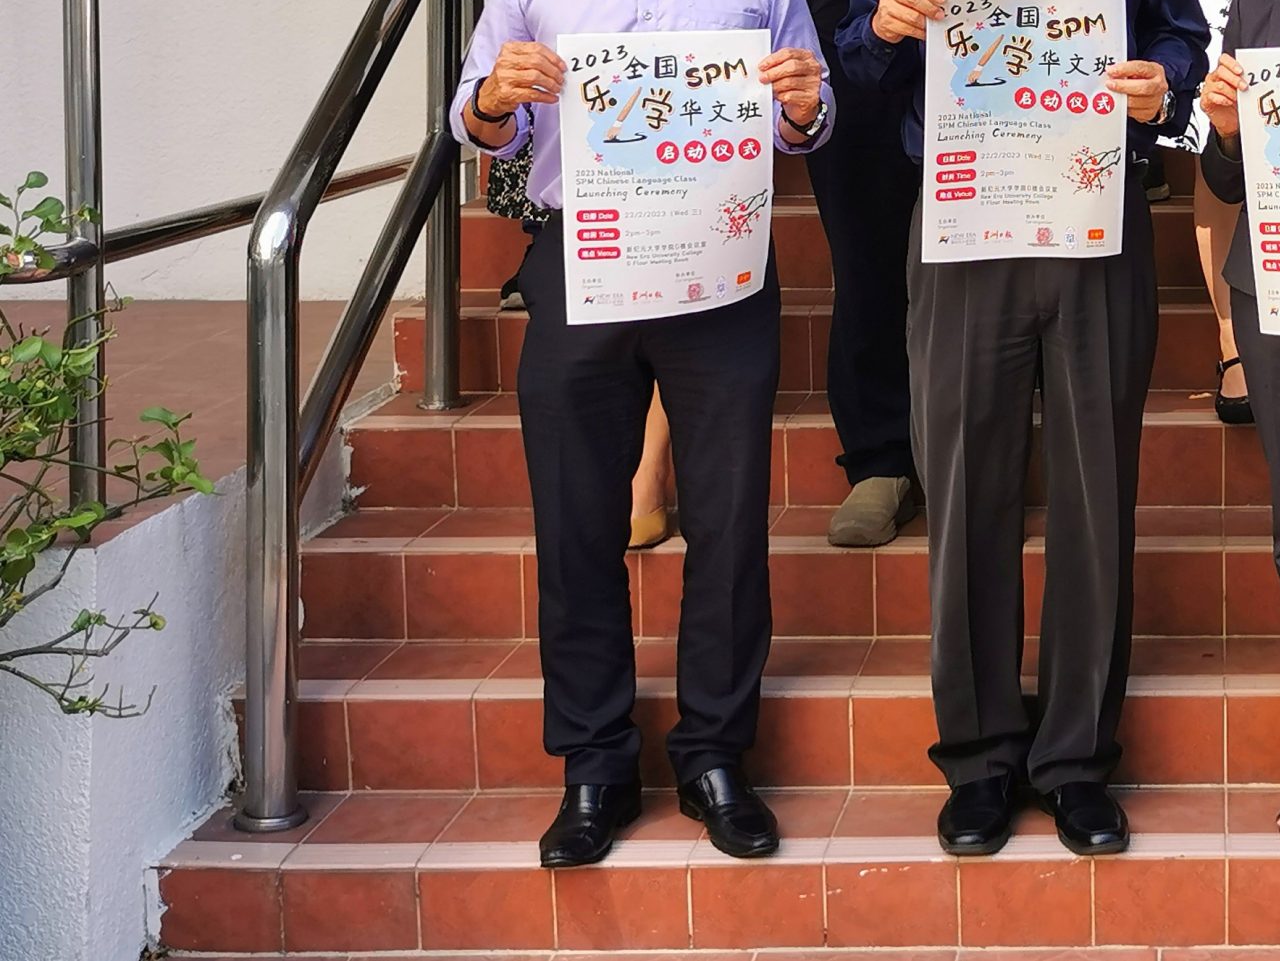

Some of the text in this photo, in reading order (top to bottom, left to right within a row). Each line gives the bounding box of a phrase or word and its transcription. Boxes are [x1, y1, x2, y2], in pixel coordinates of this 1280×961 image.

[987, 6, 1040, 28] 全国
[1047, 13, 1106, 39] SPM
[571, 45, 748, 88] 2023 全国 SPM
[680, 99, 762, 126] 华文班
[1018, 90, 1112, 111] 启动仪式
[659, 140, 760, 162] 启动仪式
[576, 187, 628, 201] Launching
